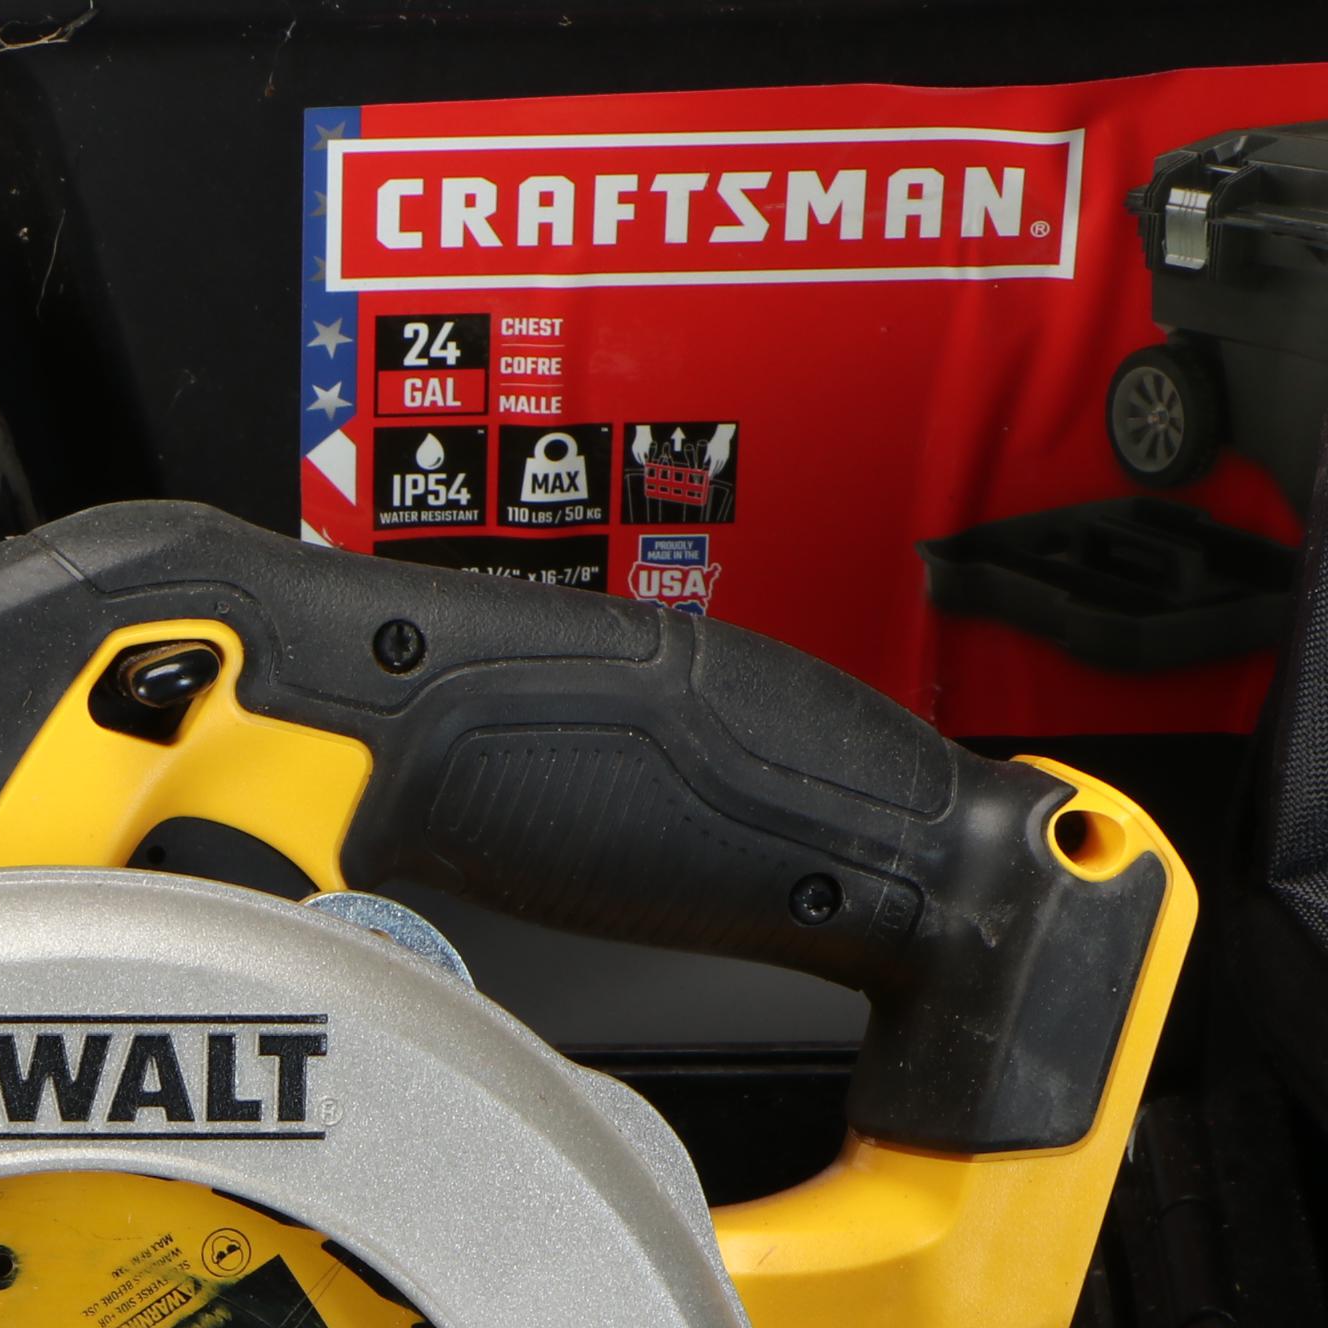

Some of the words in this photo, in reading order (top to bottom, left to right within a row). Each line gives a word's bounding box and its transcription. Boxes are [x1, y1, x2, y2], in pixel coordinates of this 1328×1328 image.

[376, 166, 1026, 250] CRAFTSMAN
[500, 317, 563, 336] CHEST
[403, 321, 461, 367] 24
[500, 357, 562, 376] COFRE
[403, 376, 461, 408] GAL
[499, 395, 562, 414] MALLE
[392, 472, 471, 507] IP54
[530, 470, 580, 494] MAX
[380, 511, 418, 525] WATER
[420, 509, 479, 523] RESISTANT
[507, 506, 529, 523] 110
[531, 510, 553, 523] LBS
[564, 506, 584, 522] 50
[586, 507, 602, 521] KG
[647, 550, 670, 561] MADE
[672, 550, 681, 560] IN
[682, 549, 700, 560] THE
[654, 540, 695, 551] PROUDLY
[639, 569, 707, 597] USA
